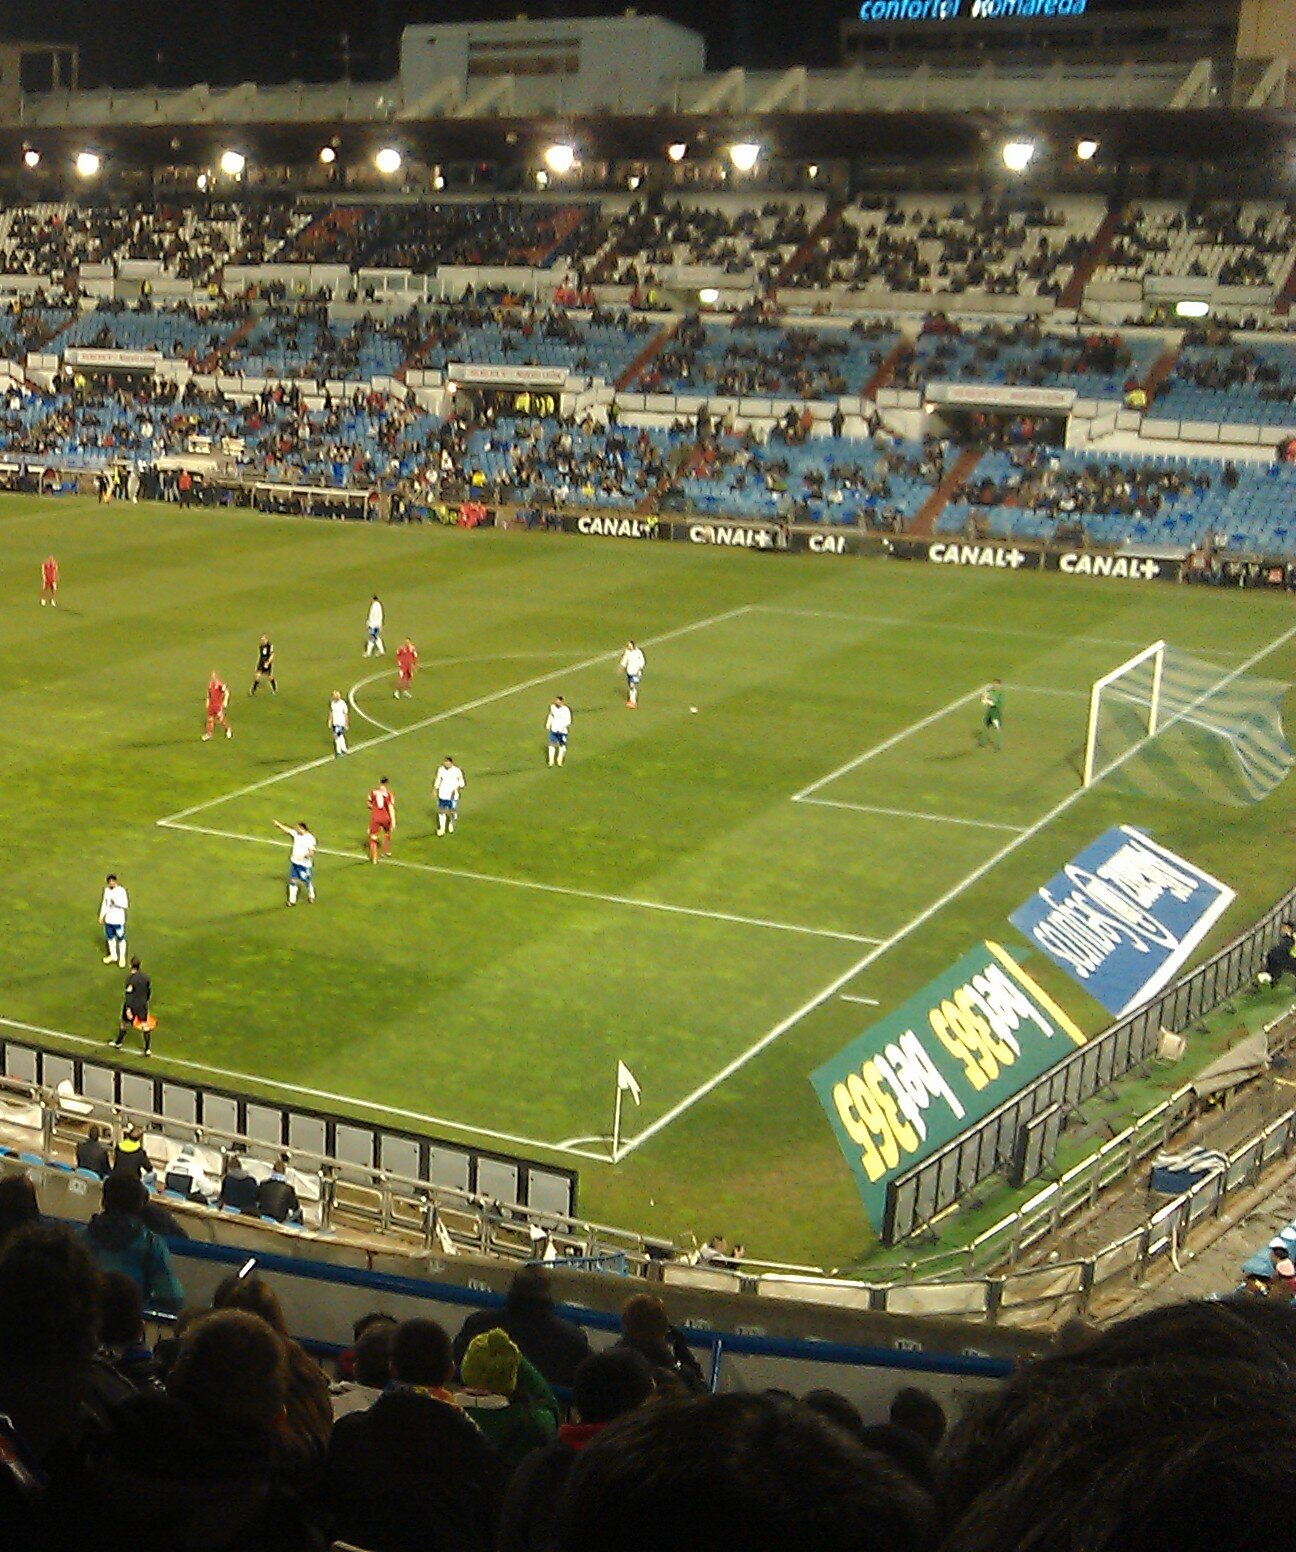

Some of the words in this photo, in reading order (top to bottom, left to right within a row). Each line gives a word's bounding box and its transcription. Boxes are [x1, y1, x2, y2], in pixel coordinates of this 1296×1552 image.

[928, 543, 1025, 569] CANAL+
[1059, 553, 1160, 580] CANAL+
[1033, 888, 1150, 979] Seguros
[928, 963, 1055, 1092] bet365
[833, 1029, 966, 1183] bet365
